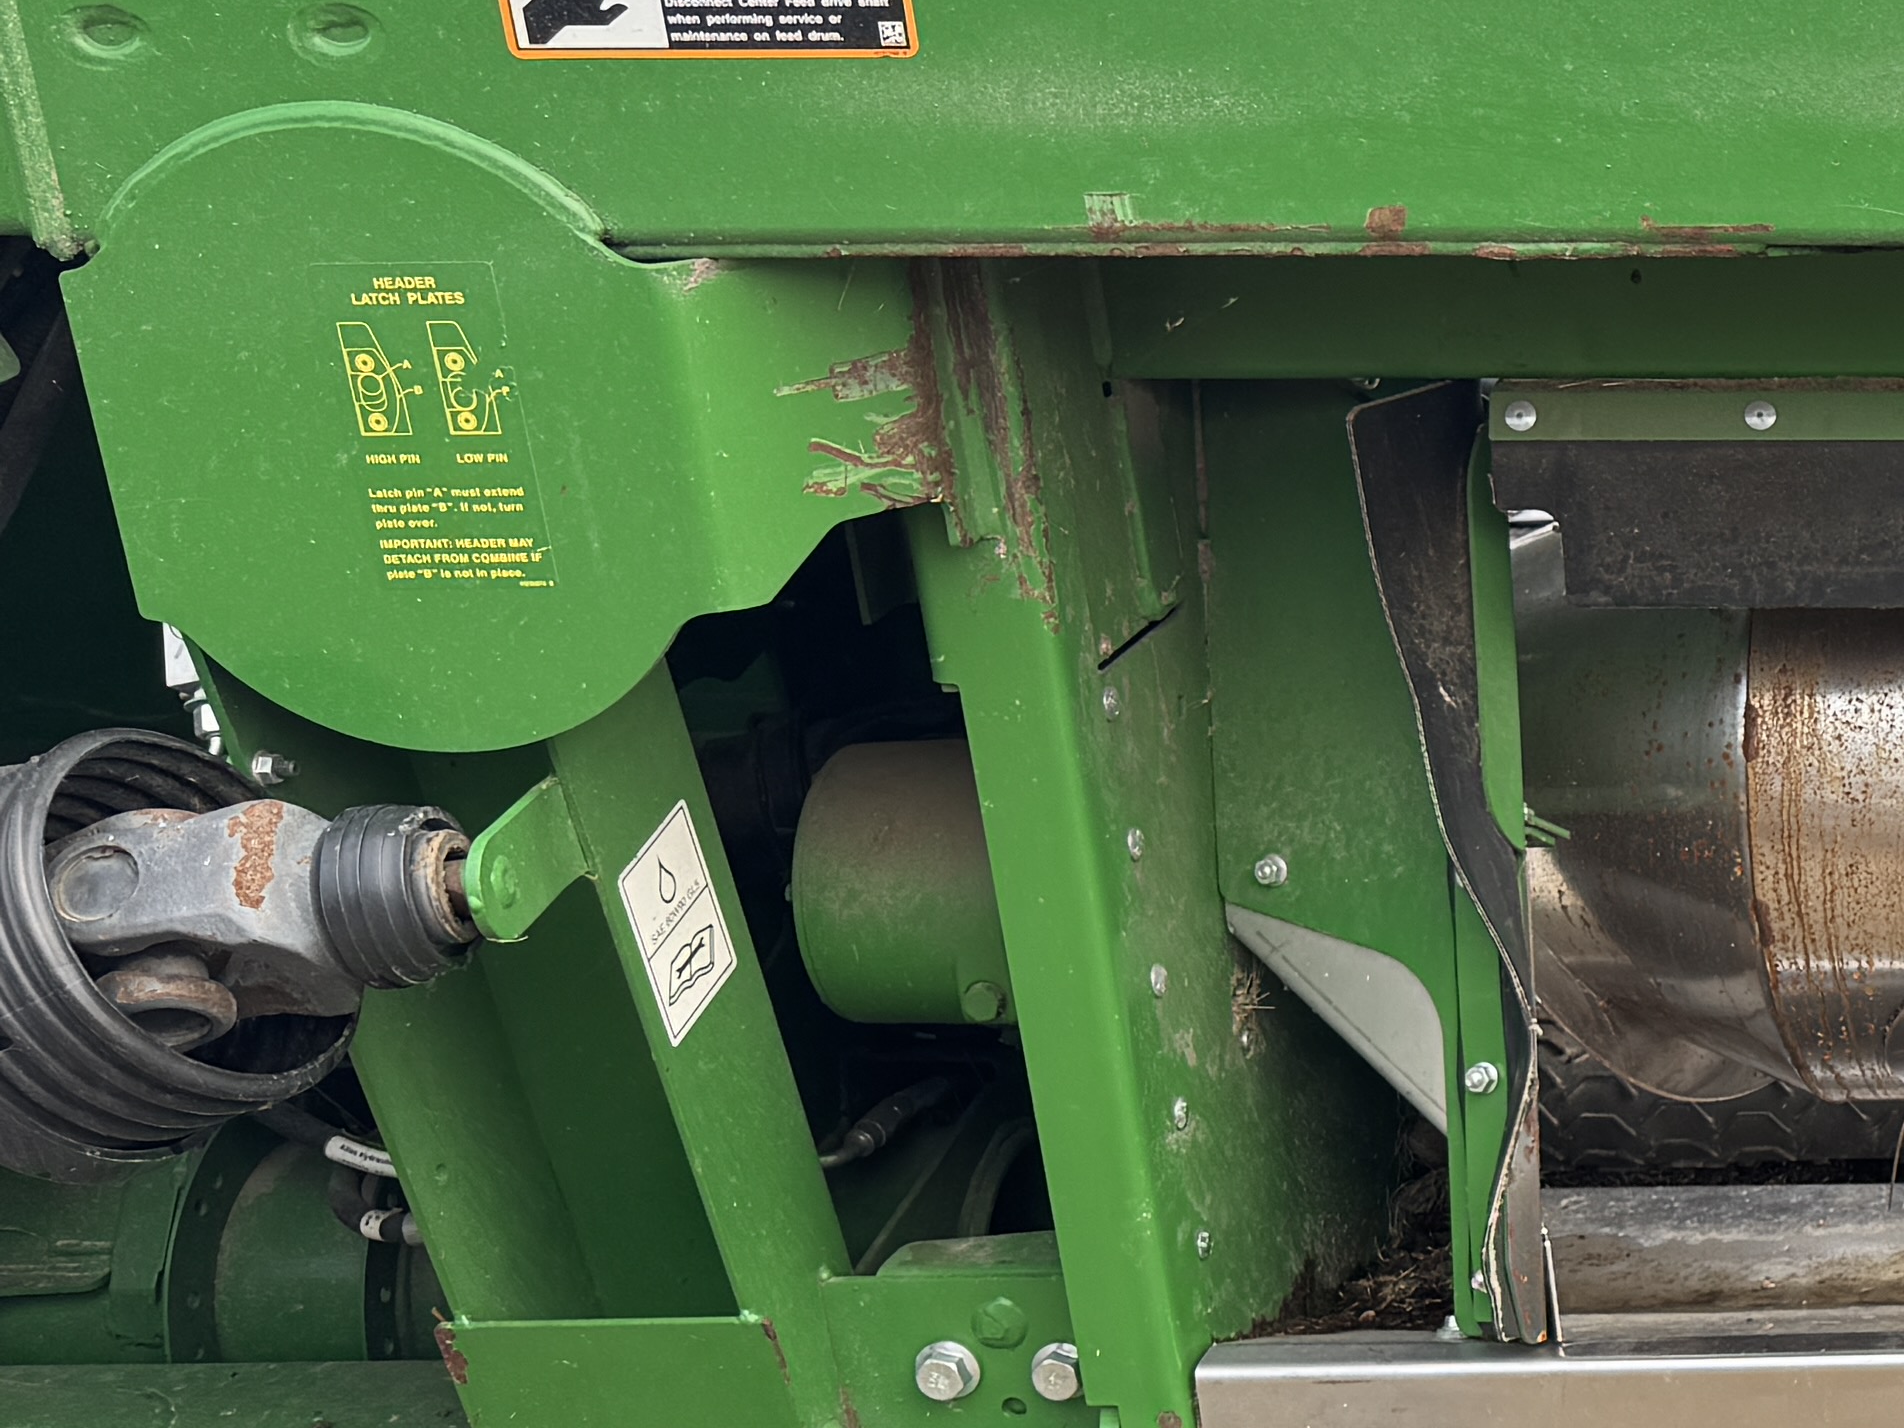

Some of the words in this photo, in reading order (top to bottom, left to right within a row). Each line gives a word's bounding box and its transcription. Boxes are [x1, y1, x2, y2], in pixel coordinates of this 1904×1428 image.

[667, 13, 700, 25] when
[706, 13, 774, 27] performing
[779, 13, 823, 24] service
[828, 14, 842, 24] or
[670, 30, 748, 42] maintenance
[753, 32, 770, 42] on
[775, 30, 802, 42] feed
[808, 30, 844, 42] drum.
[373, 276, 436, 289] HEADER
[351, 293, 400, 305] LATCH
[407, 292, 464, 305] PLATES
[402, 359, 412, 369] A
[495, 369, 504, 378] A
[413, 385, 423, 395] B
[366, 454, 396, 464] HIGH
[399, 454, 421, 464] PIN
[456, 453, 483, 464] LOW
[487, 453, 509, 463] PIN
[368, 488, 402, 498] Latch
[405, 487, 425, 499] pin
[450, 487, 481, 497] must
[483, 487, 524, 497] extend
[371, 504, 397, 513] thru
[400, 502, 430, 514] plate
[460, 502, 469, 511] If
[472, 502, 497, 513] not,
[498, 502, 524, 511] turn
[376, 518, 406, 530] plate
[408, 519, 438, 528] over.
[380, 539, 453, 549] IMPORTANT:
[455, 538, 506, 549] HEADER
[508, 538, 534, 548] MAY
[383, 554, 432, 565] DETACH
[434, 553, 470, 563] FROM
[472, 553, 529, 564] COMBINE
[531, 553, 543, 562] IF
[386, 569, 416, 581] plate
[440, 568, 452, 579] is
[454, 568, 474, 578] not
[476, 568, 488, 578] in
[490, 568, 526, 580] place.
